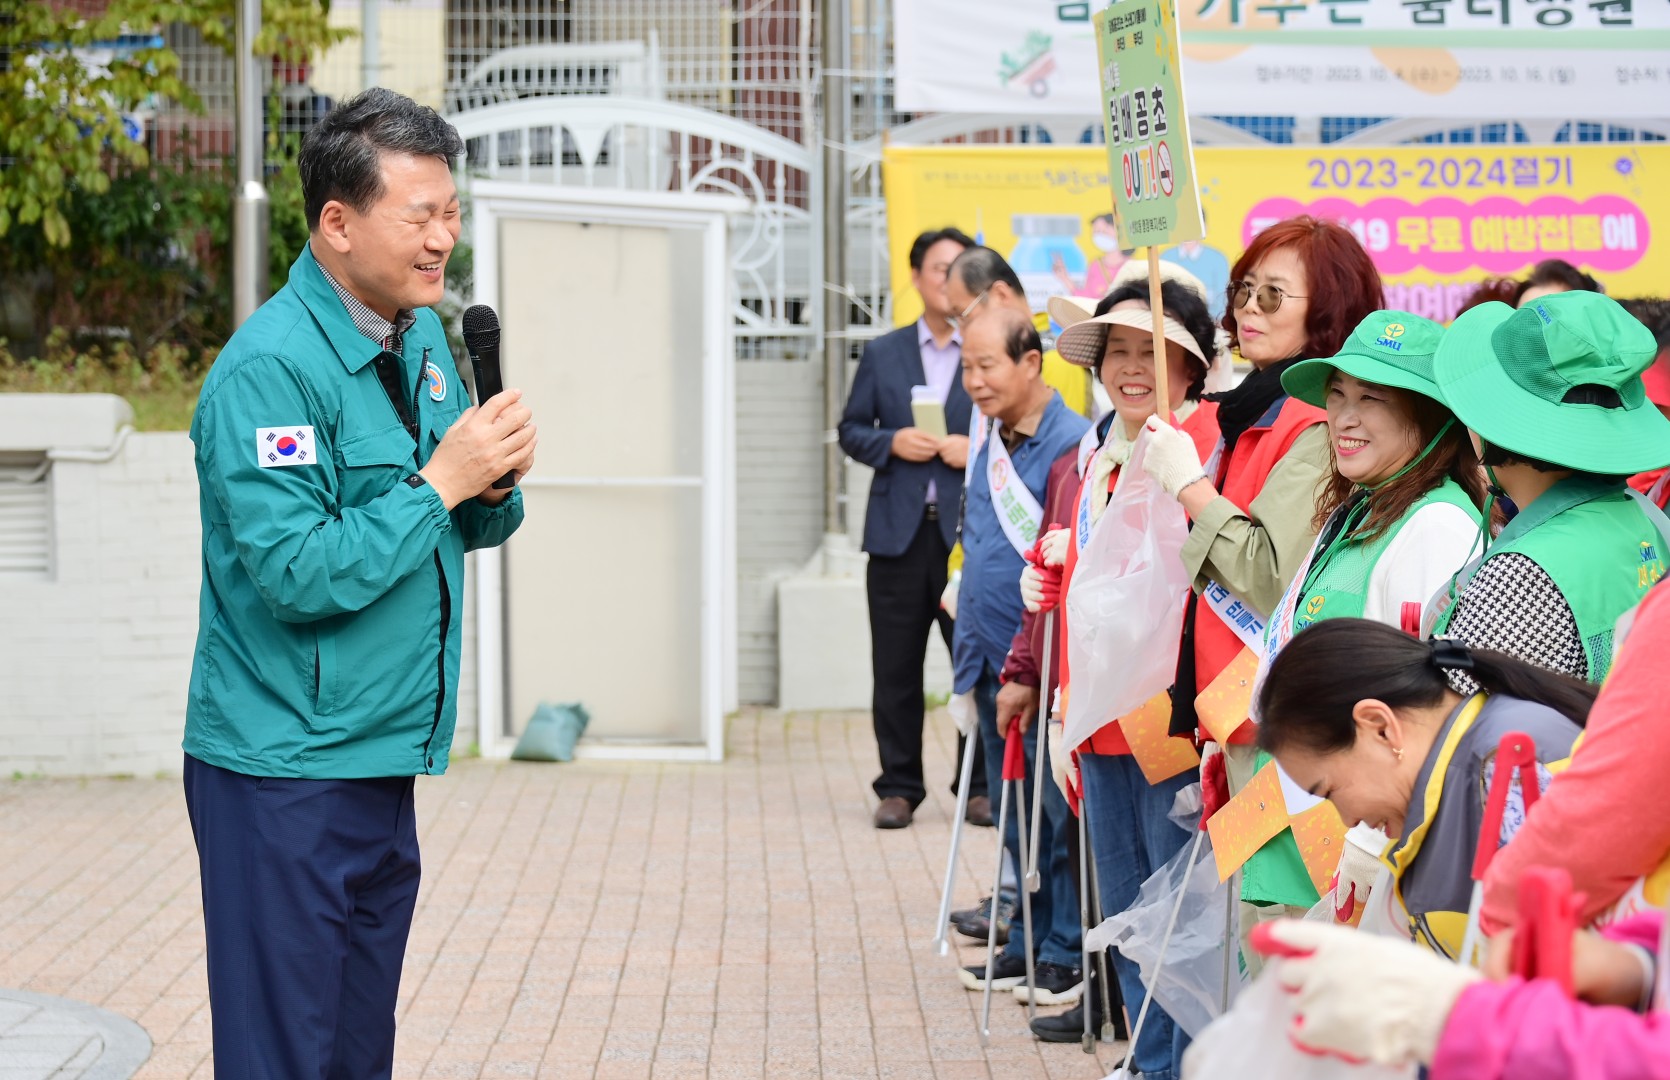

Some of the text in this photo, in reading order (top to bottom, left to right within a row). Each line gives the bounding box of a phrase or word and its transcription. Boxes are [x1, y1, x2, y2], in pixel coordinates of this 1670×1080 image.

[1122, 145, 1158, 200] OUT!
[1307, 157, 1574, 189] 2023-2024절기
[1396, 217, 1465, 254] 무료
[1470, 213, 1637, 253] 예방접종에
[1374, 336, 1402, 352] SMU
